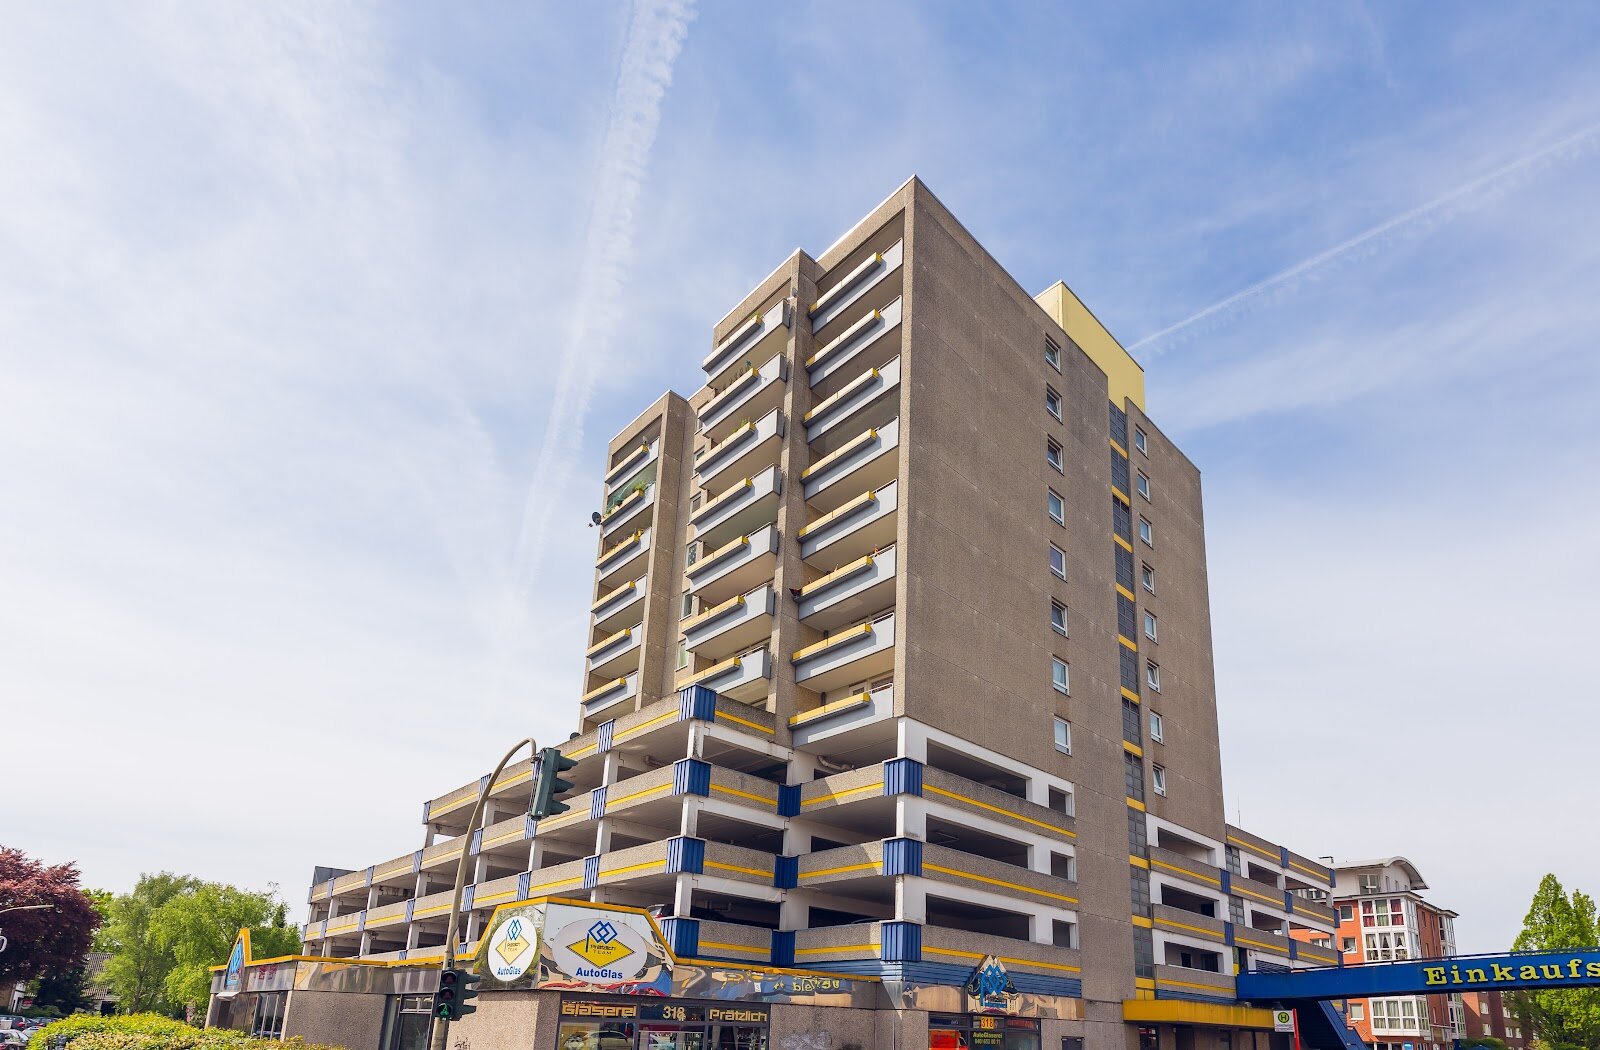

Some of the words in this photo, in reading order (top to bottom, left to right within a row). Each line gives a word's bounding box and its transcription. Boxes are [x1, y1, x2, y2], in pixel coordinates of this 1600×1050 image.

[497, 965, 521, 976] AutoGlas
[575, 967, 623, 979] AutoGlas
[1423, 958, 1600, 985] Einkaufs
[662, 1005, 685, 1020] 318
[709, 1008, 768, 1022] Prätzlich
